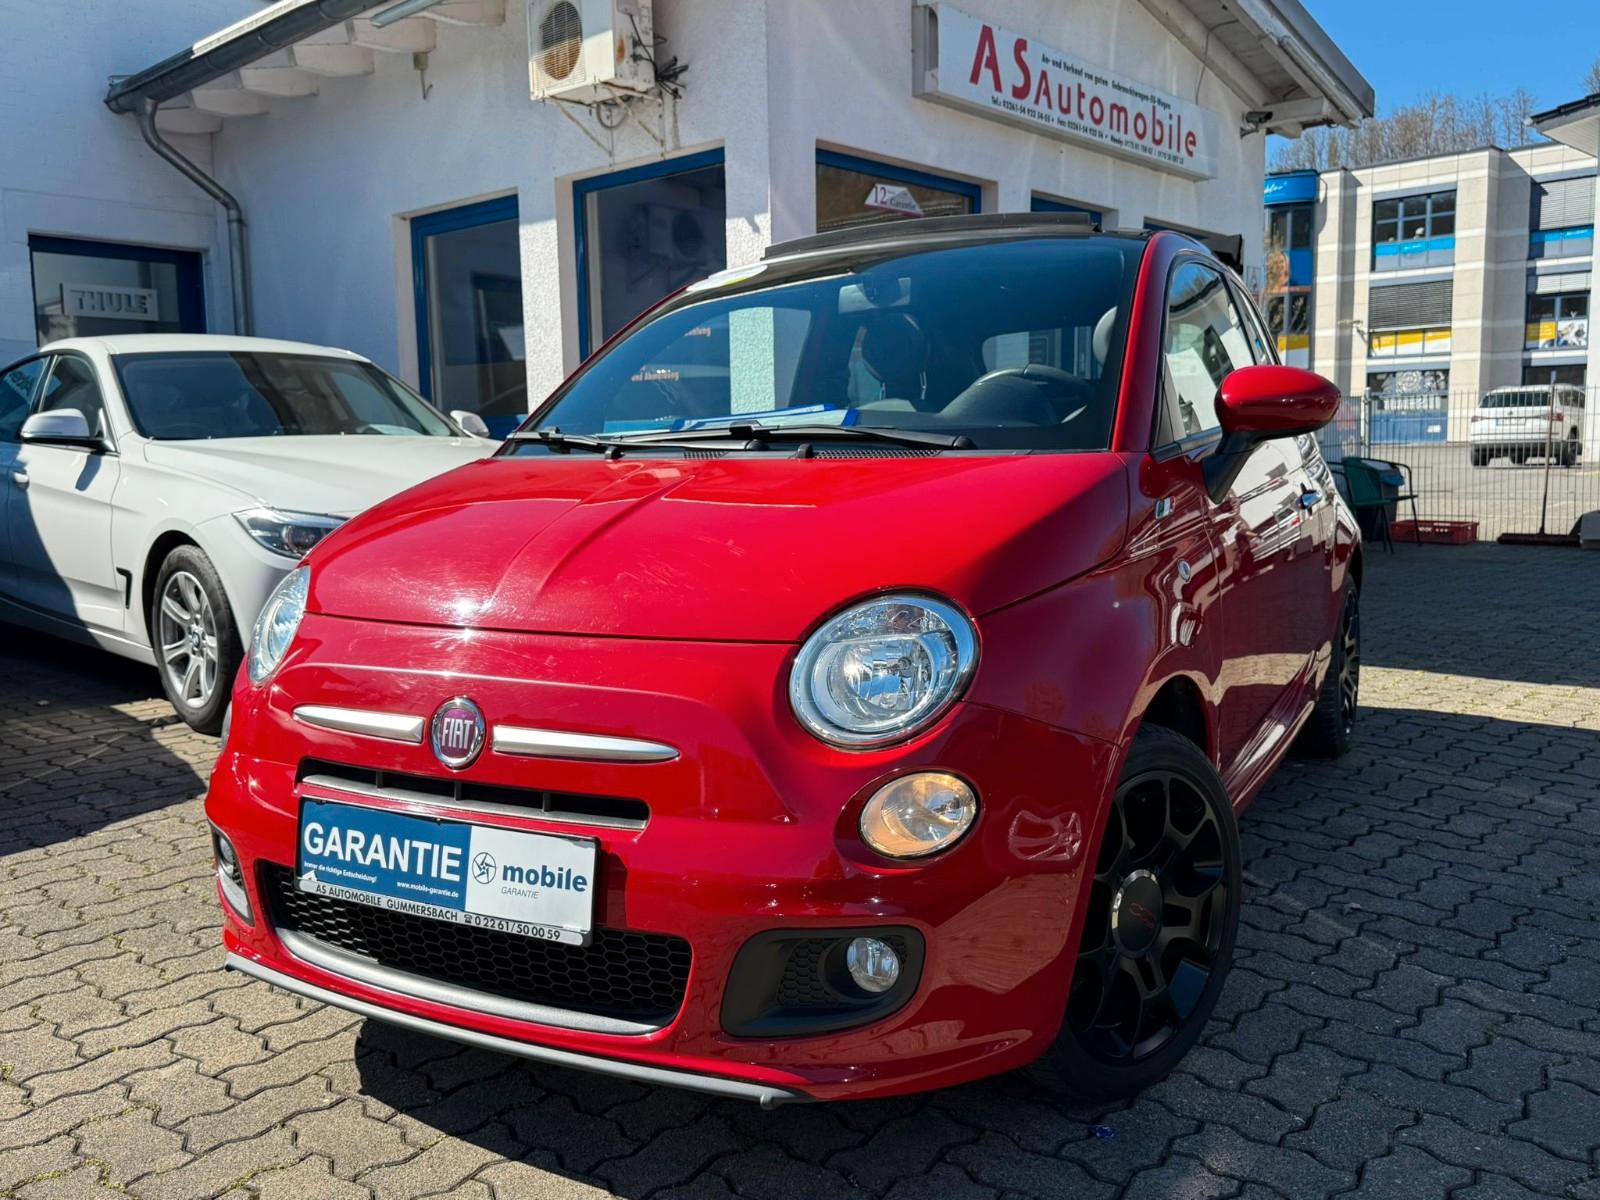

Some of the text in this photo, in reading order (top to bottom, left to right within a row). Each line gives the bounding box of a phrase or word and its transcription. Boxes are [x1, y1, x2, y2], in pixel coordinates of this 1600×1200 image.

[874, 184, 887, 205] 12
[69, 288, 149, 315] THULE
[441, 717, 474, 750] FIAT
[303, 821, 462, 882] GARANTIE
[396, 881, 459, 899] www.mobile-garantie.de
[502, 864, 588, 892] mobile
[315, 884, 327, 895] AS
[329, 887, 382, 906] AUTOMOBILE
[386, 900, 458, 921] GUMMERSBACH
[501, 886, 539, 899] GARANTIE
